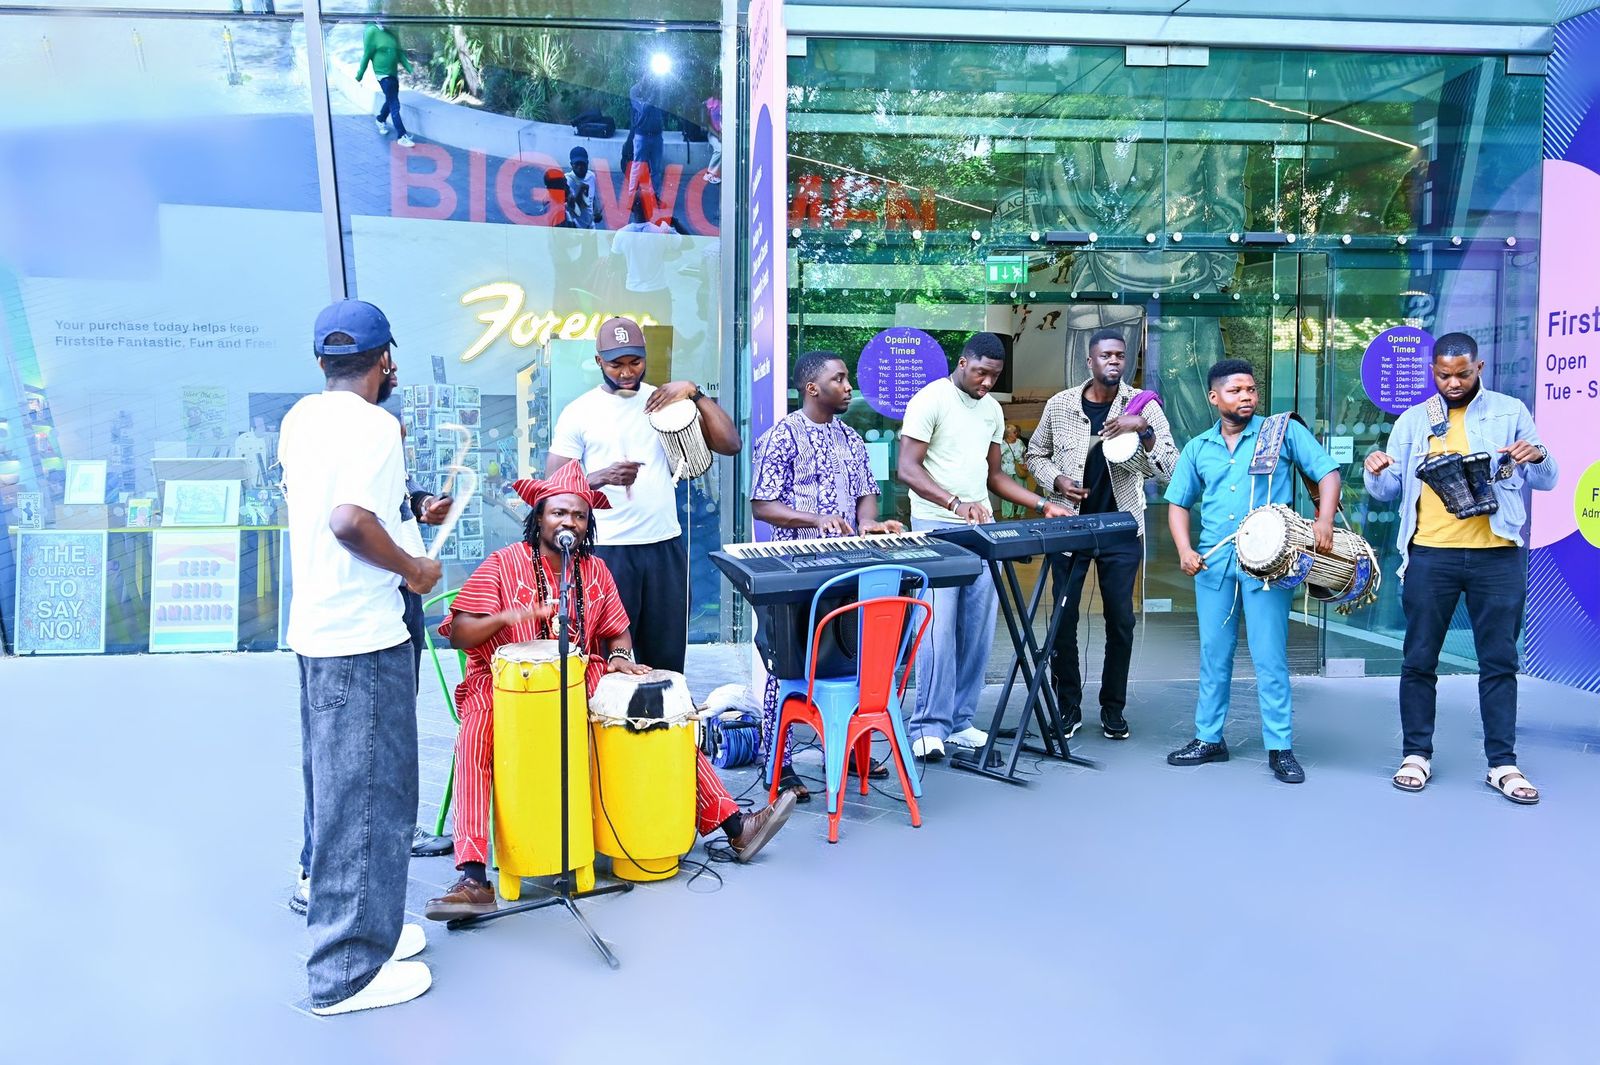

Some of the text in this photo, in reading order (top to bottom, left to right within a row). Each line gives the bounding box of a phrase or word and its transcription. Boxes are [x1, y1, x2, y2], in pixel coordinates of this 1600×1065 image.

[390, 141, 567, 227] BIG
[55, 320, 259, 334] Your purchase today helps keep
[461, 282, 658, 363] Fore
[1548, 306, 1600, 337] First
[55, 336, 114, 347] Firstsite
[190, 338, 213, 348] Fun
[218, 338, 241, 348] and
[885, 336, 921, 345] Opening
[1387, 335, 1421, 344] Opening
[1546, 354, 1587, 374] Open
[1545, 383, 1571, 400] Tue
[1588, 380, 1600, 398] S
[994, 529, 1020, 538] YAMAHA
[40, 546, 85, 563] THE
[28, 566, 95, 577] COURAGE
[178, 560, 221, 577] KEEP
[46, 579, 77, 598] TO
[171, 582, 223, 599] BEING
[37, 600, 82, 619] SAY
[157, 604, 234, 621] AMAZING
[38, 621, 82, 640] NO!
